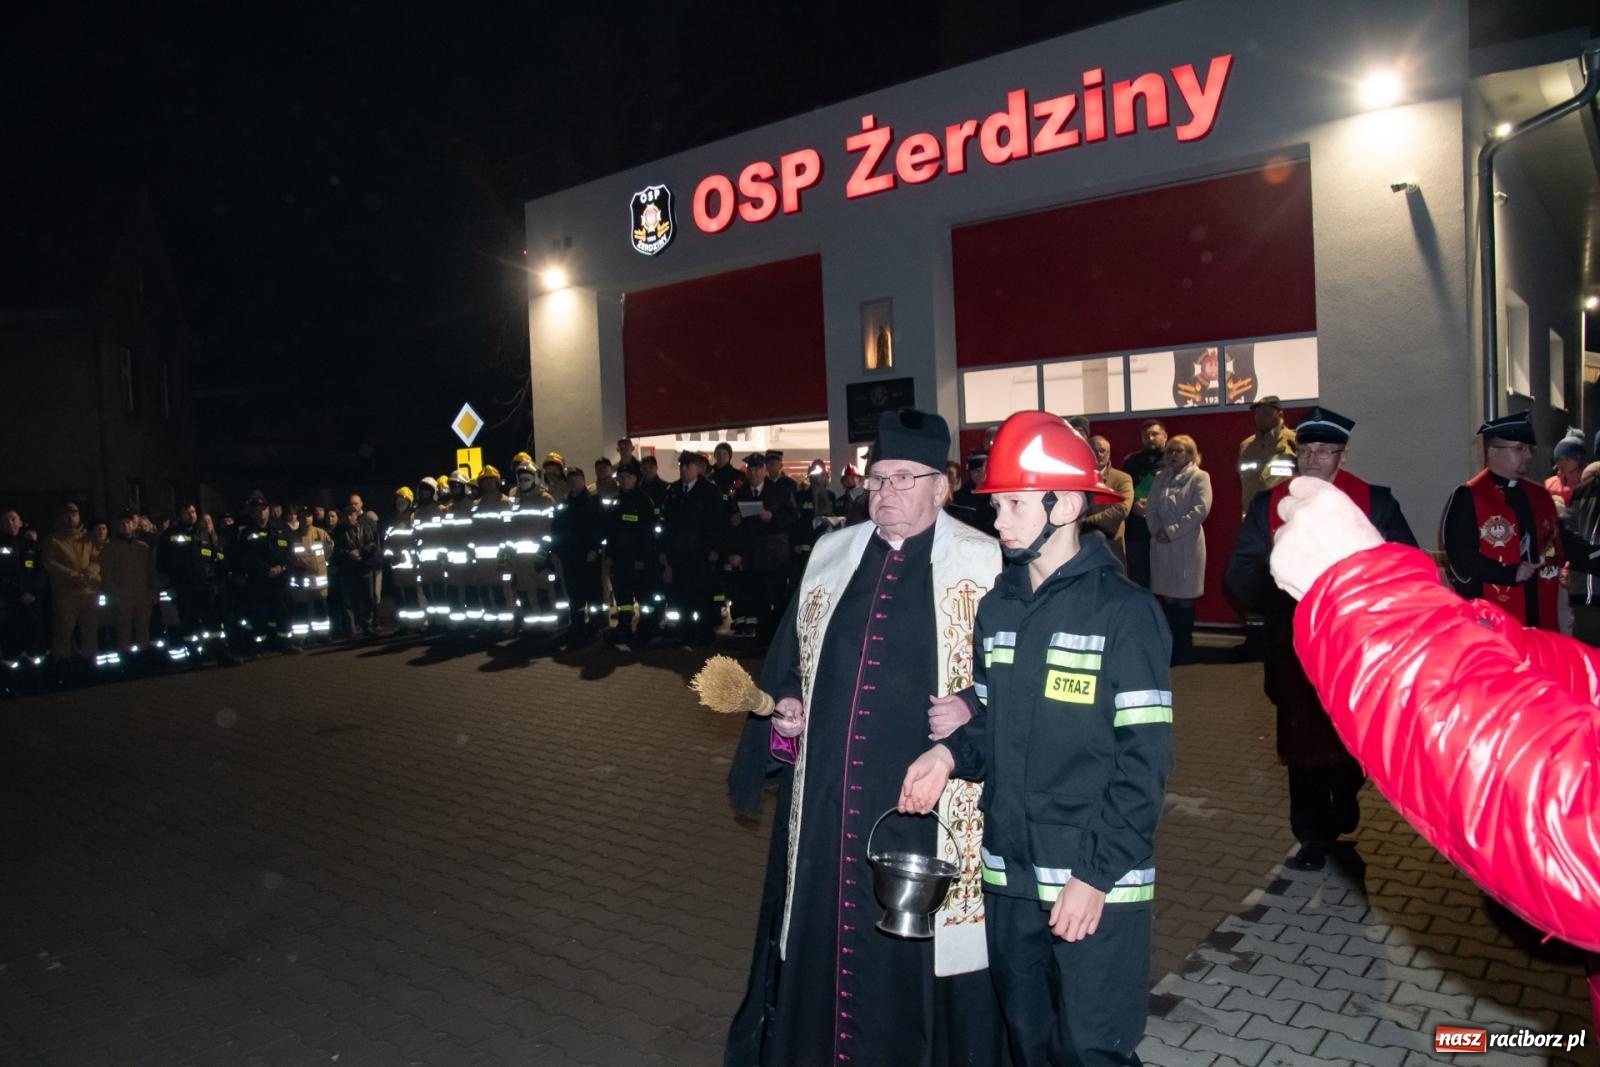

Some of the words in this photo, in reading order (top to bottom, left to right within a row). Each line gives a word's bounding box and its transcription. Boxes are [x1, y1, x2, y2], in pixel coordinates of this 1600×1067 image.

[692, 148, 822, 234] OSP
[845, 53, 1235, 199] Żerdziny
[640, 189, 660, 204] OSP
